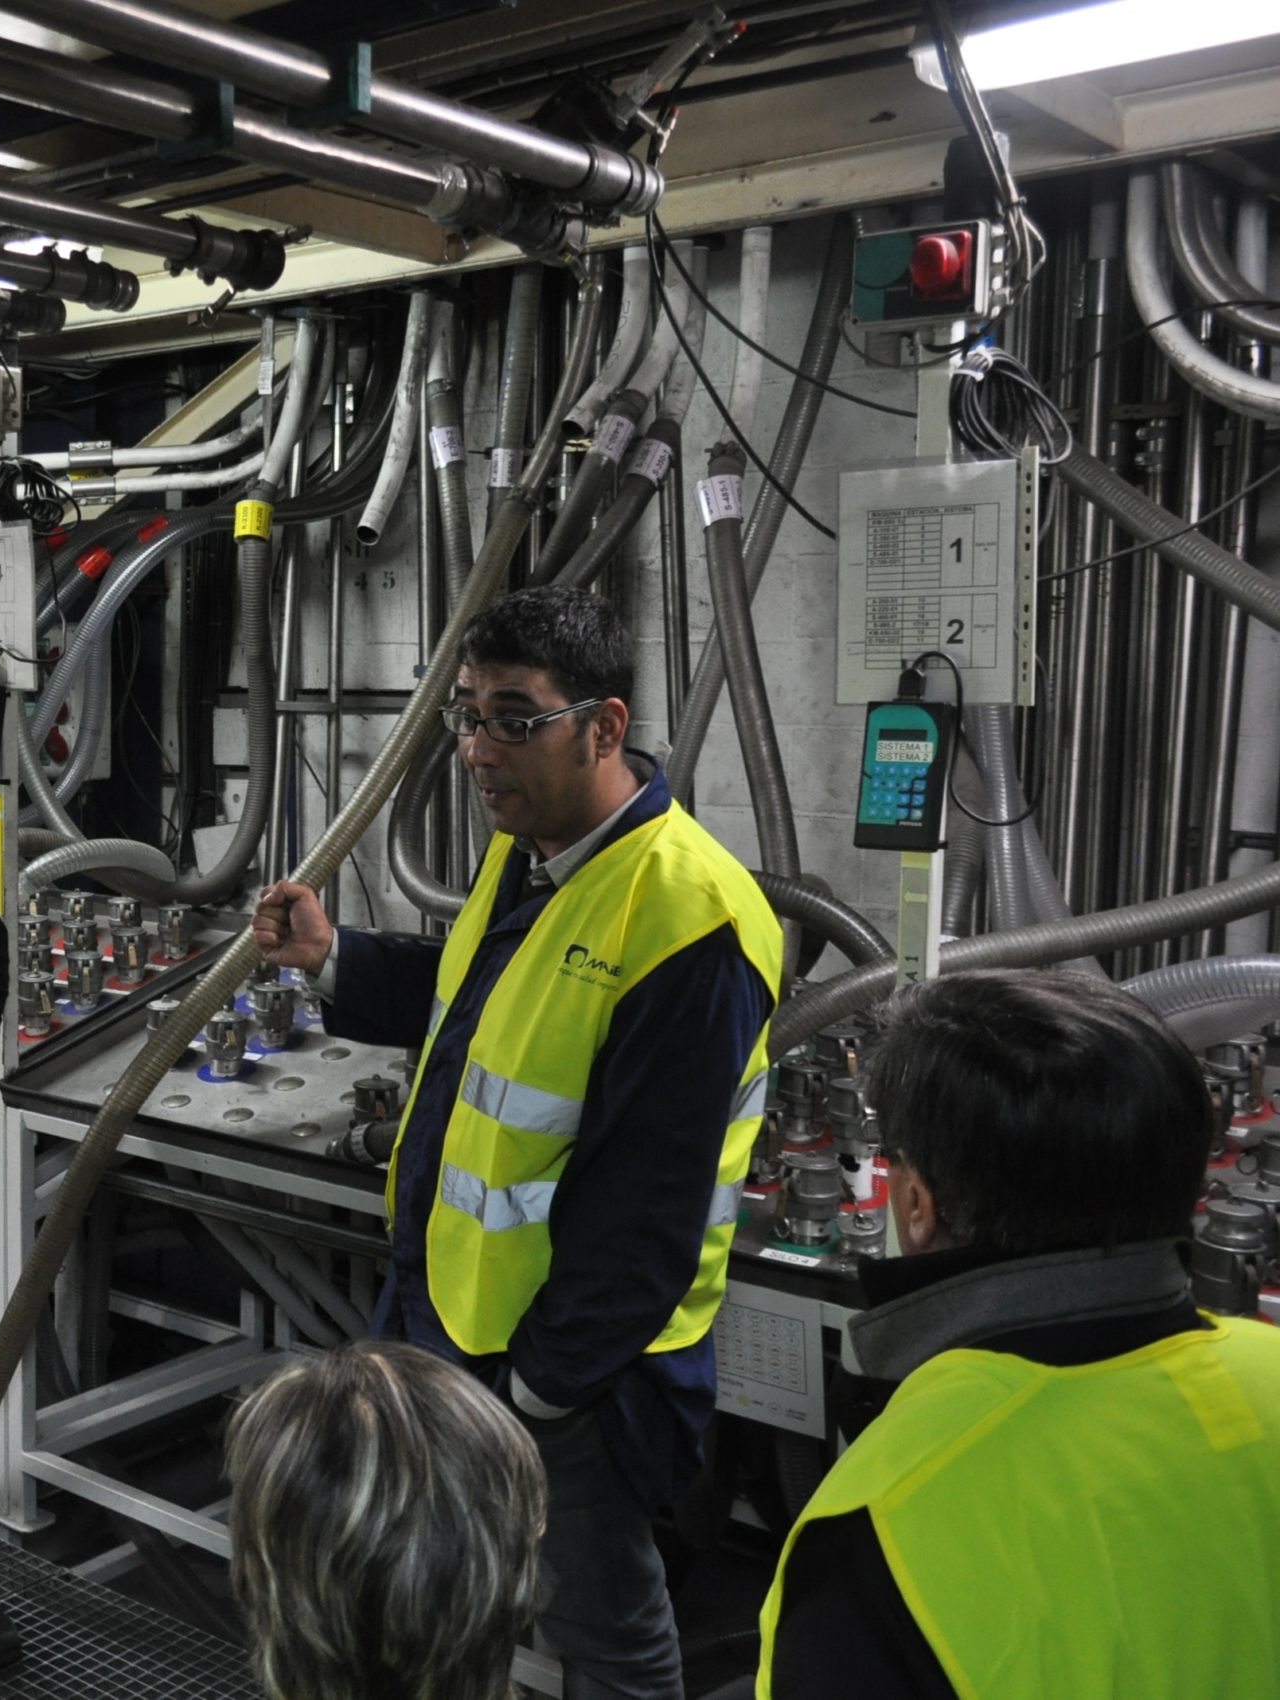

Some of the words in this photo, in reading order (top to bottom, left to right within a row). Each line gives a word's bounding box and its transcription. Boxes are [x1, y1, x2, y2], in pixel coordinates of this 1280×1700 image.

[718, 479, 734, 512] S-485-1
[949, 537, 963, 563] 1
[382, 570, 396, 590] 5
[946, 618, 965, 645] 2
[878, 742, 921, 751] SISTEMA
[924, 743, 929, 751] 1
[878, 752, 921, 761] SISTEMA
[768, 1250, 800, 1263] SILO
